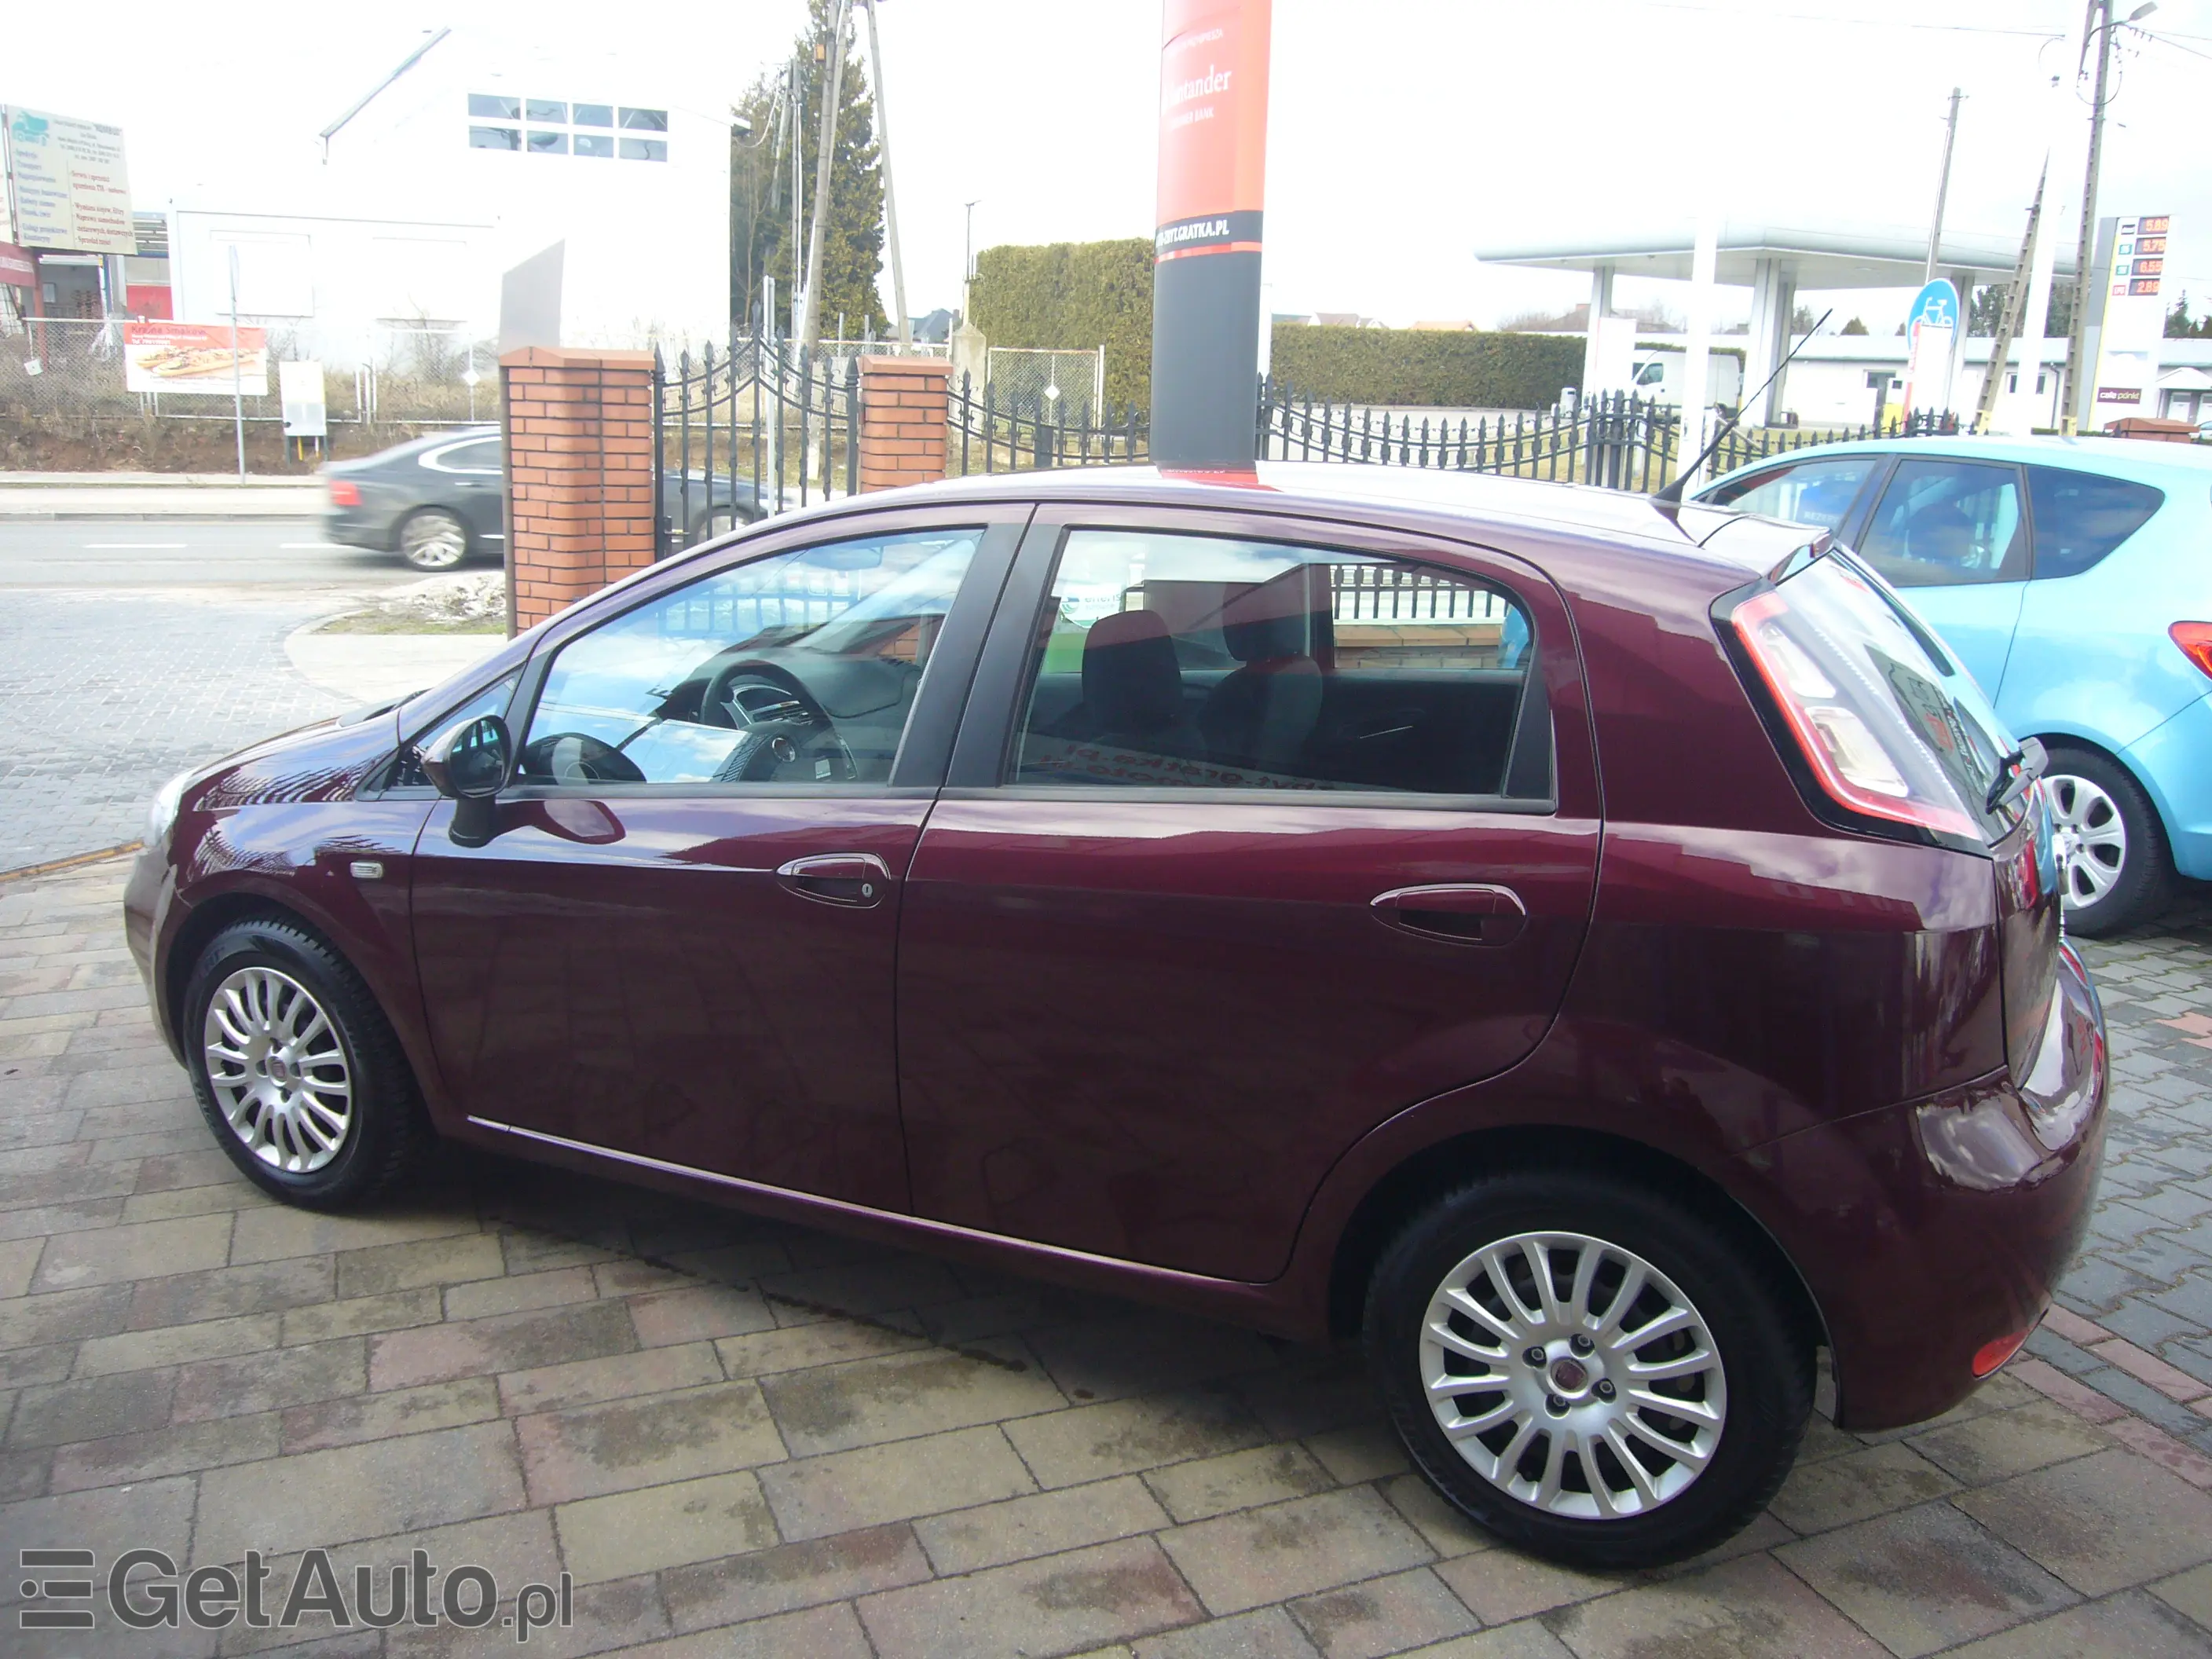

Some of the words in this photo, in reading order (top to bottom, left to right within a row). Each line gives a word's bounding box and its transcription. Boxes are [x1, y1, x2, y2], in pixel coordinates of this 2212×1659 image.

[2145, 219, 2168, 232] 5.89
[2142, 239, 2166, 252] 5.75
[2137, 281, 2160, 293] 2.89
[131, 325, 163, 335] Krana
